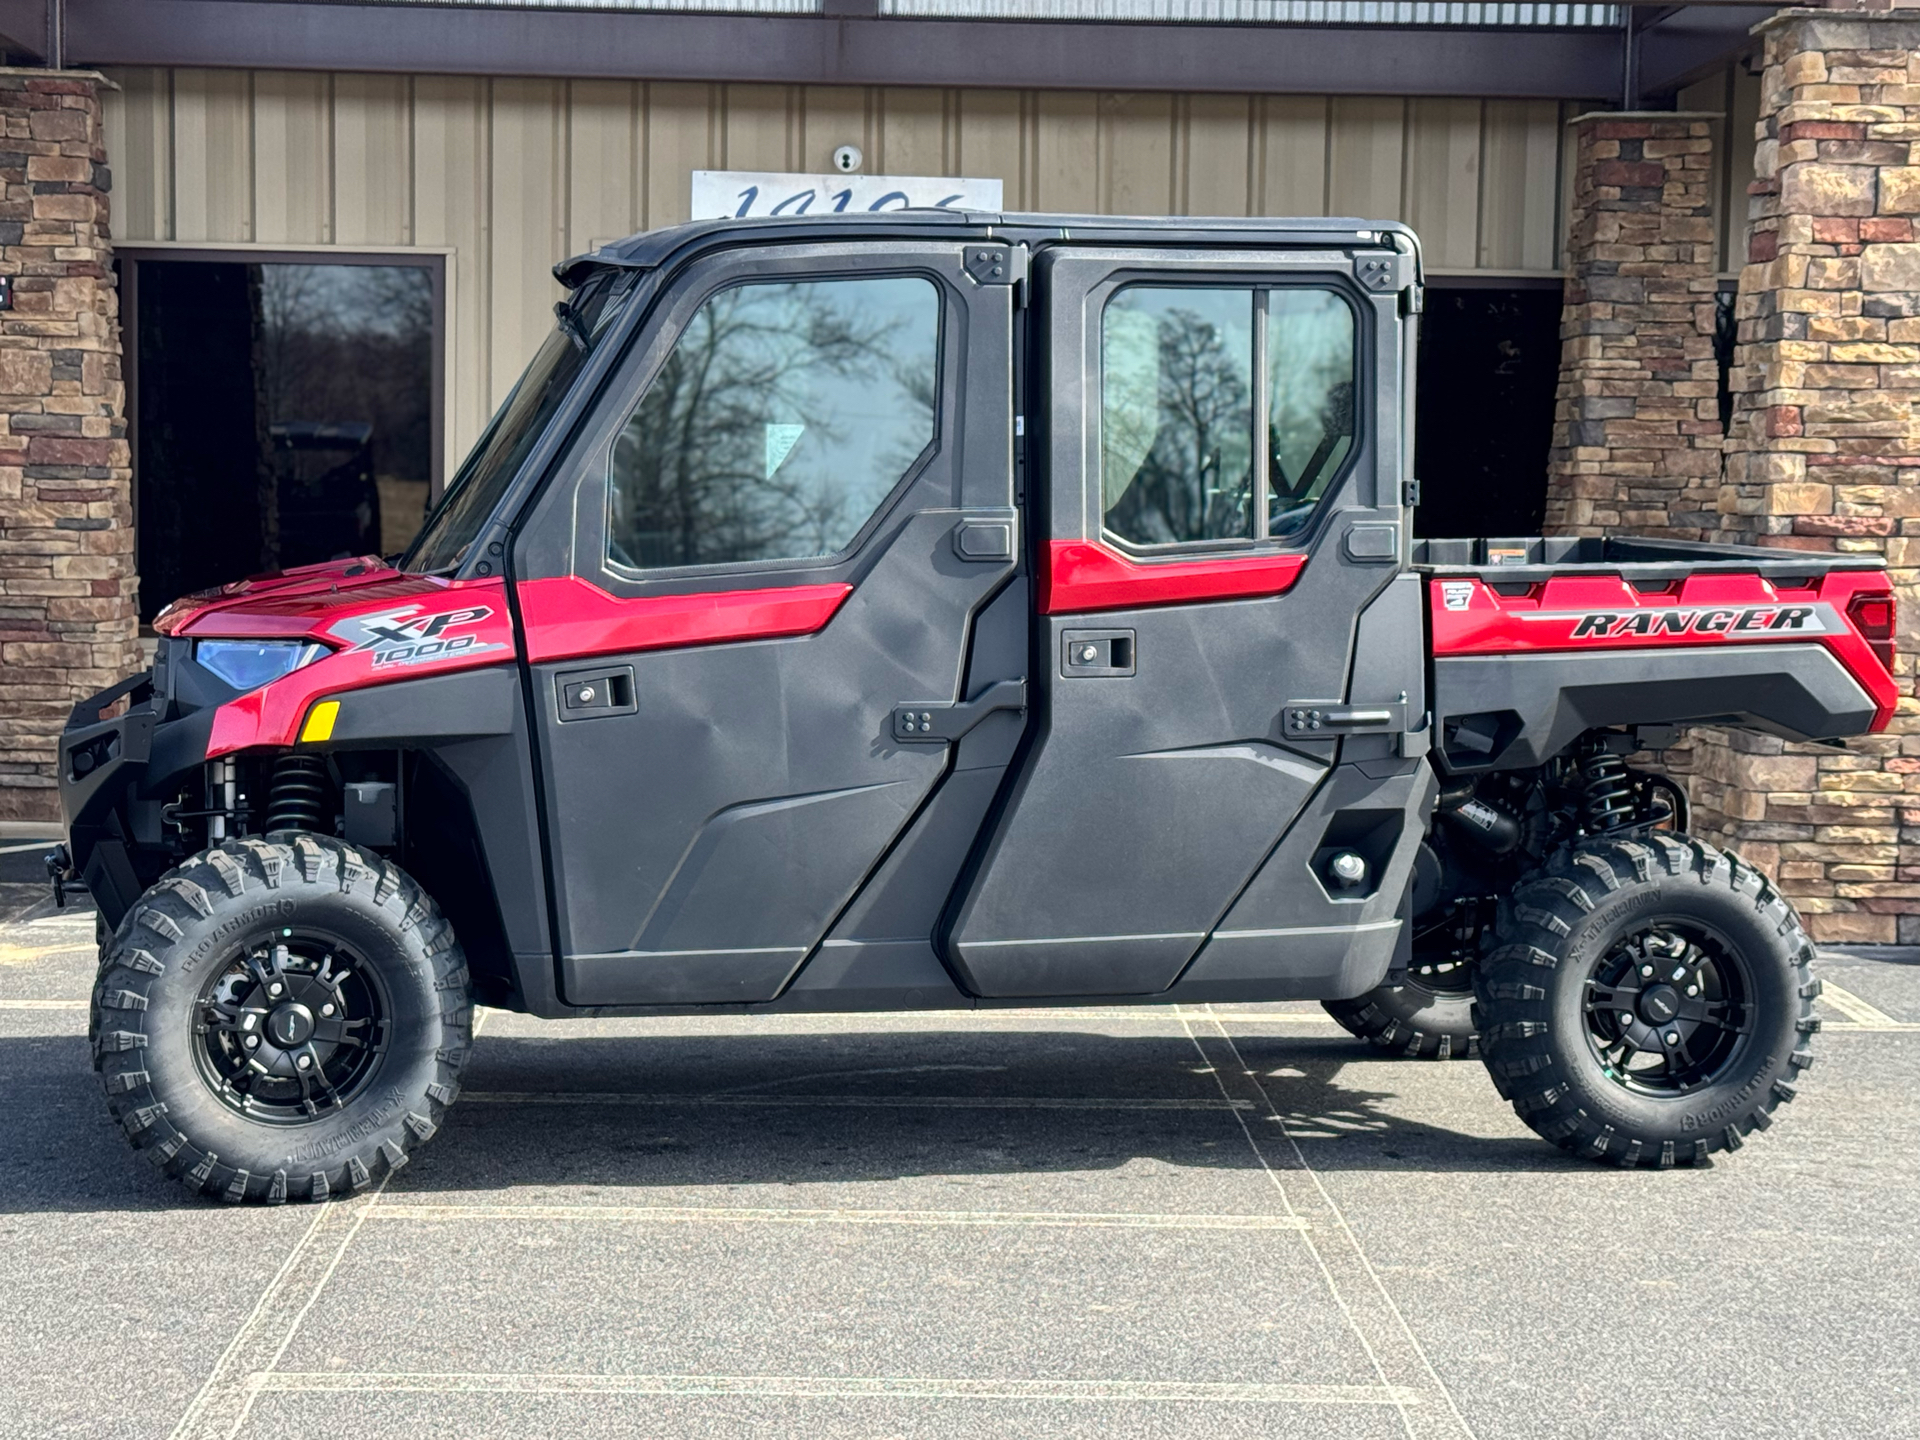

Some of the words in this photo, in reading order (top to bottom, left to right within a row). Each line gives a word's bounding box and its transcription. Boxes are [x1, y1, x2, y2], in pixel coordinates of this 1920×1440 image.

[345, 606, 494, 653] XP
[1570, 605, 1816, 639] RANGER
[372, 634, 477, 667] 1000
[182, 941, 213, 973] PRO
[213, 903, 277, 942] ARMOR
[1698, 1086, 1753, 1127] ARMOR
